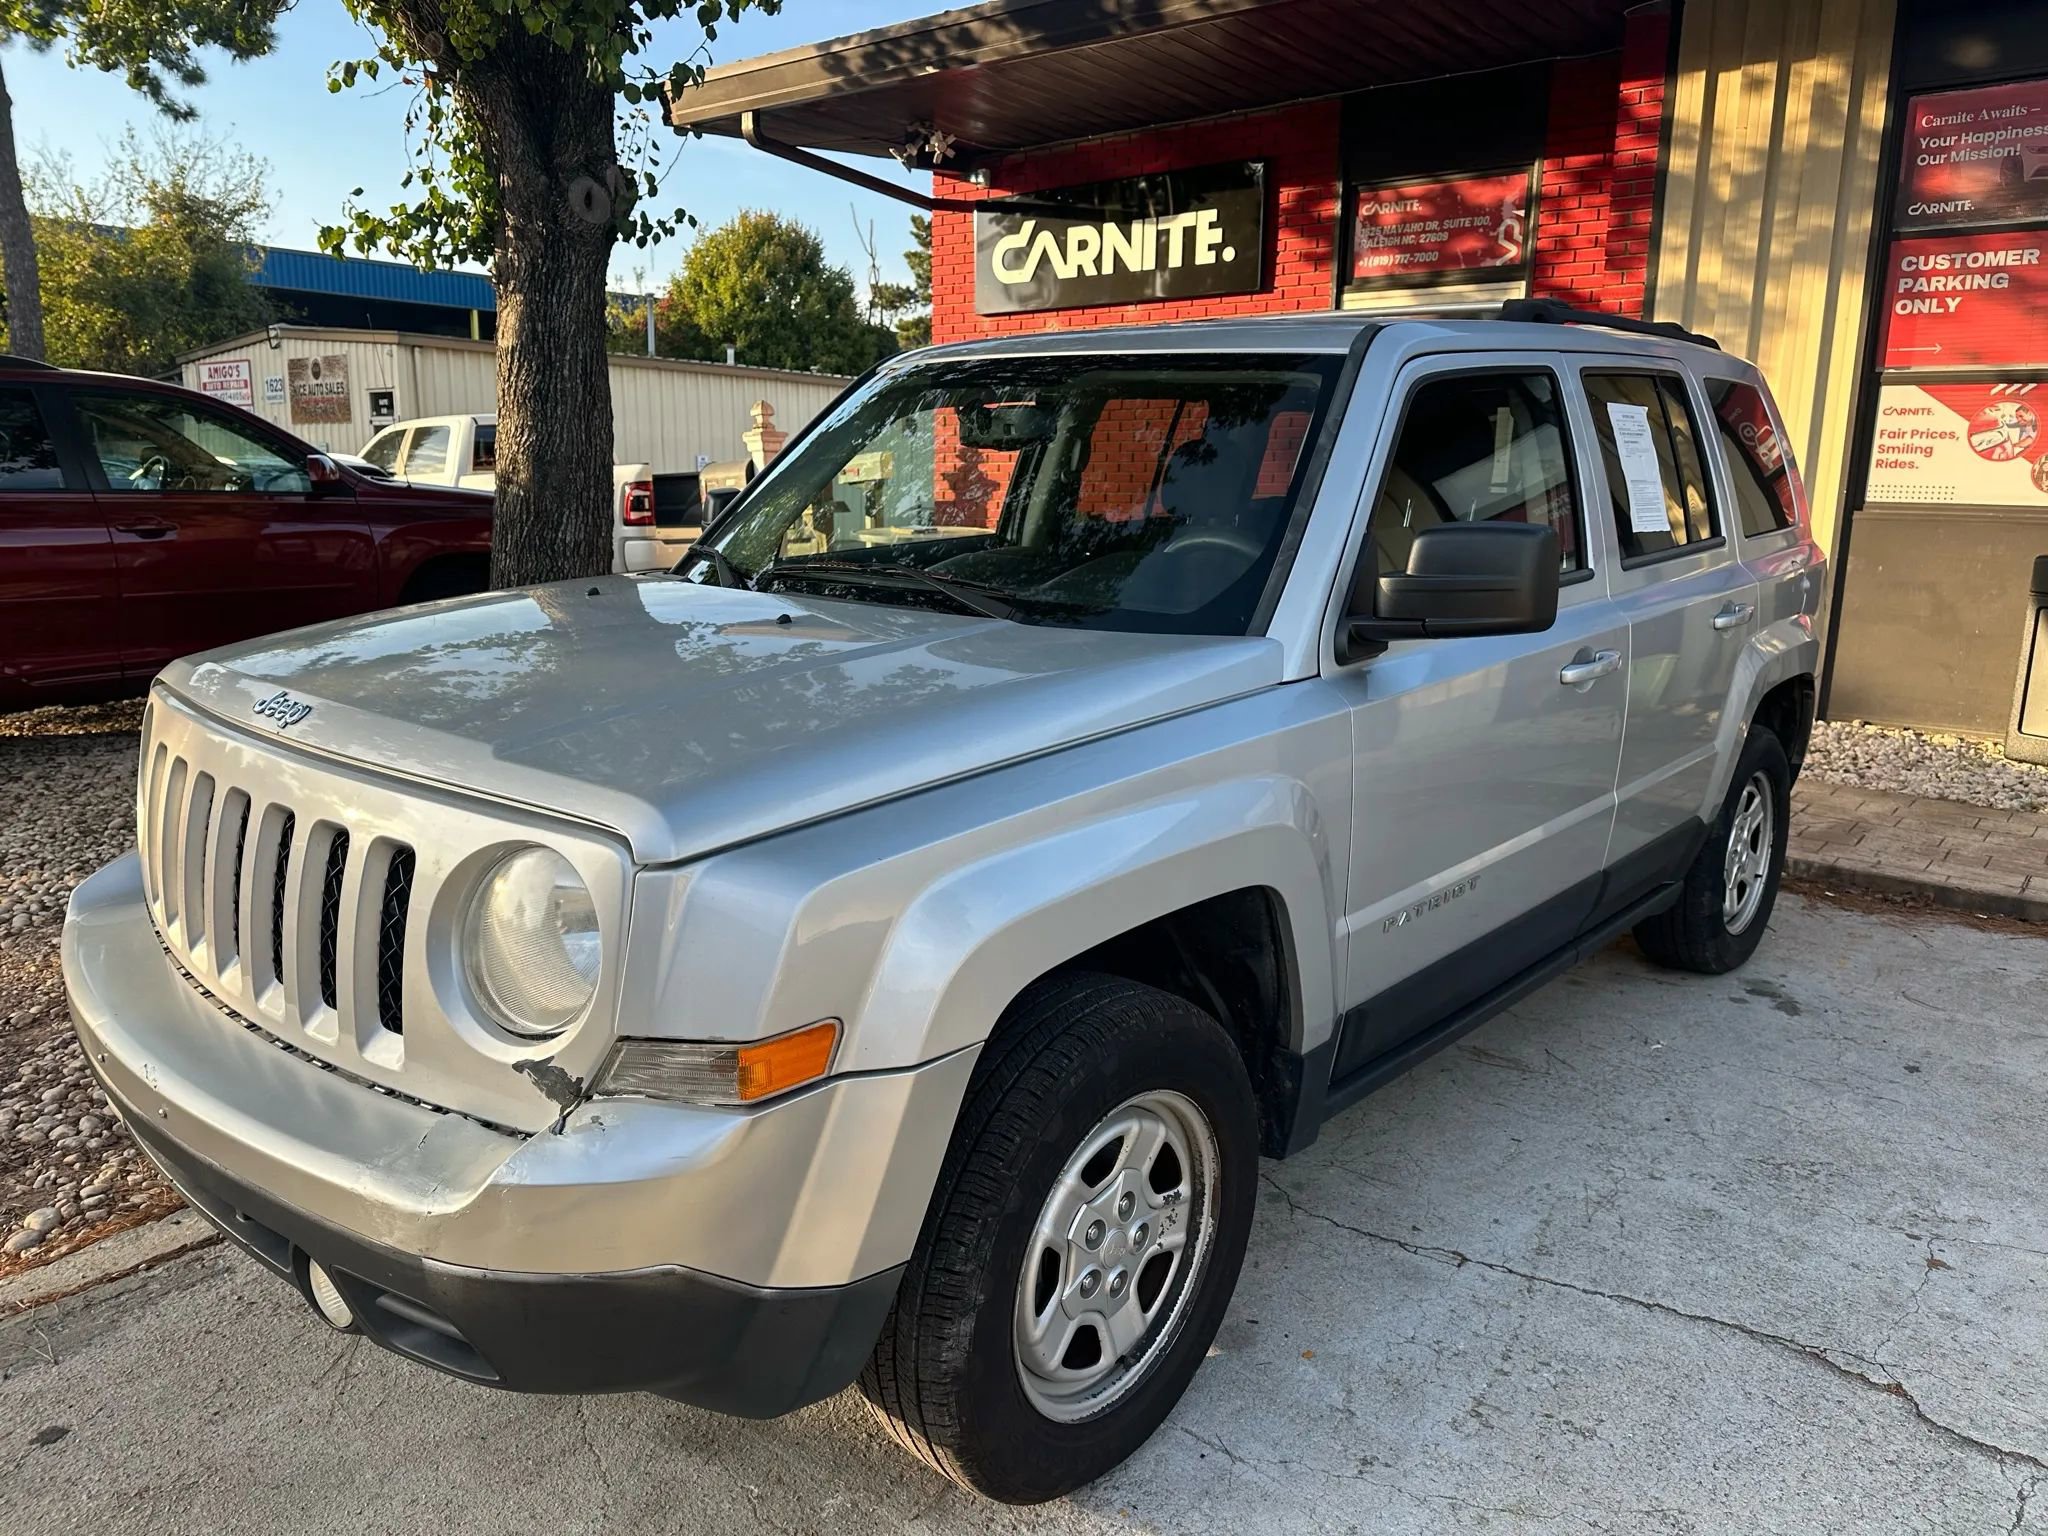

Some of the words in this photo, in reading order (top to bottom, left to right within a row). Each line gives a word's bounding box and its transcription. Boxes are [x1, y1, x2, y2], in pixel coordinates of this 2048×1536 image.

[1921, 111, 1974, 128] Carnite
[1978, 104, 2028, 121] Awaits
[1919, 135, 1958, 149] Your
[1960, 125, 2048, 145] Happiness
[1916, 153, 1947, 166] Our
[1950, 144, 2020, 162] Mission!
[1383, 222, 1424, 235] NAVAHO
[1425, 220, 1441, 231] DR,
[1442, 217, 1473, 229] SUITE
[1473, 215, 1492, 226] 100,
[1360, 236, 1401, 249] RALEIGH
[1418, 231, 1449, 243] 27609
[1900, 249, 2040, 272] CUSTOMER
[1897, 272, 2010, 293] PARKING
[1894, 296, 1963, 315] ONLY
[207, 364, 241, 379] AMIGO'S
[265, 378, 283, 393] 1623
[308, 383, 324, 396] AUTO
[325, 381, 344, 395] SALES
[1879, 428, 1908, 440] Fair
[1910, 428, 1960, 441] Prices,
[1877, 443, 1933, 457] Smiling
[1875, 458, 1919, 469] Rides.
[253, 690, 313, 729] Jeep
[1382, 874, 1481, 934] PATRIOT
